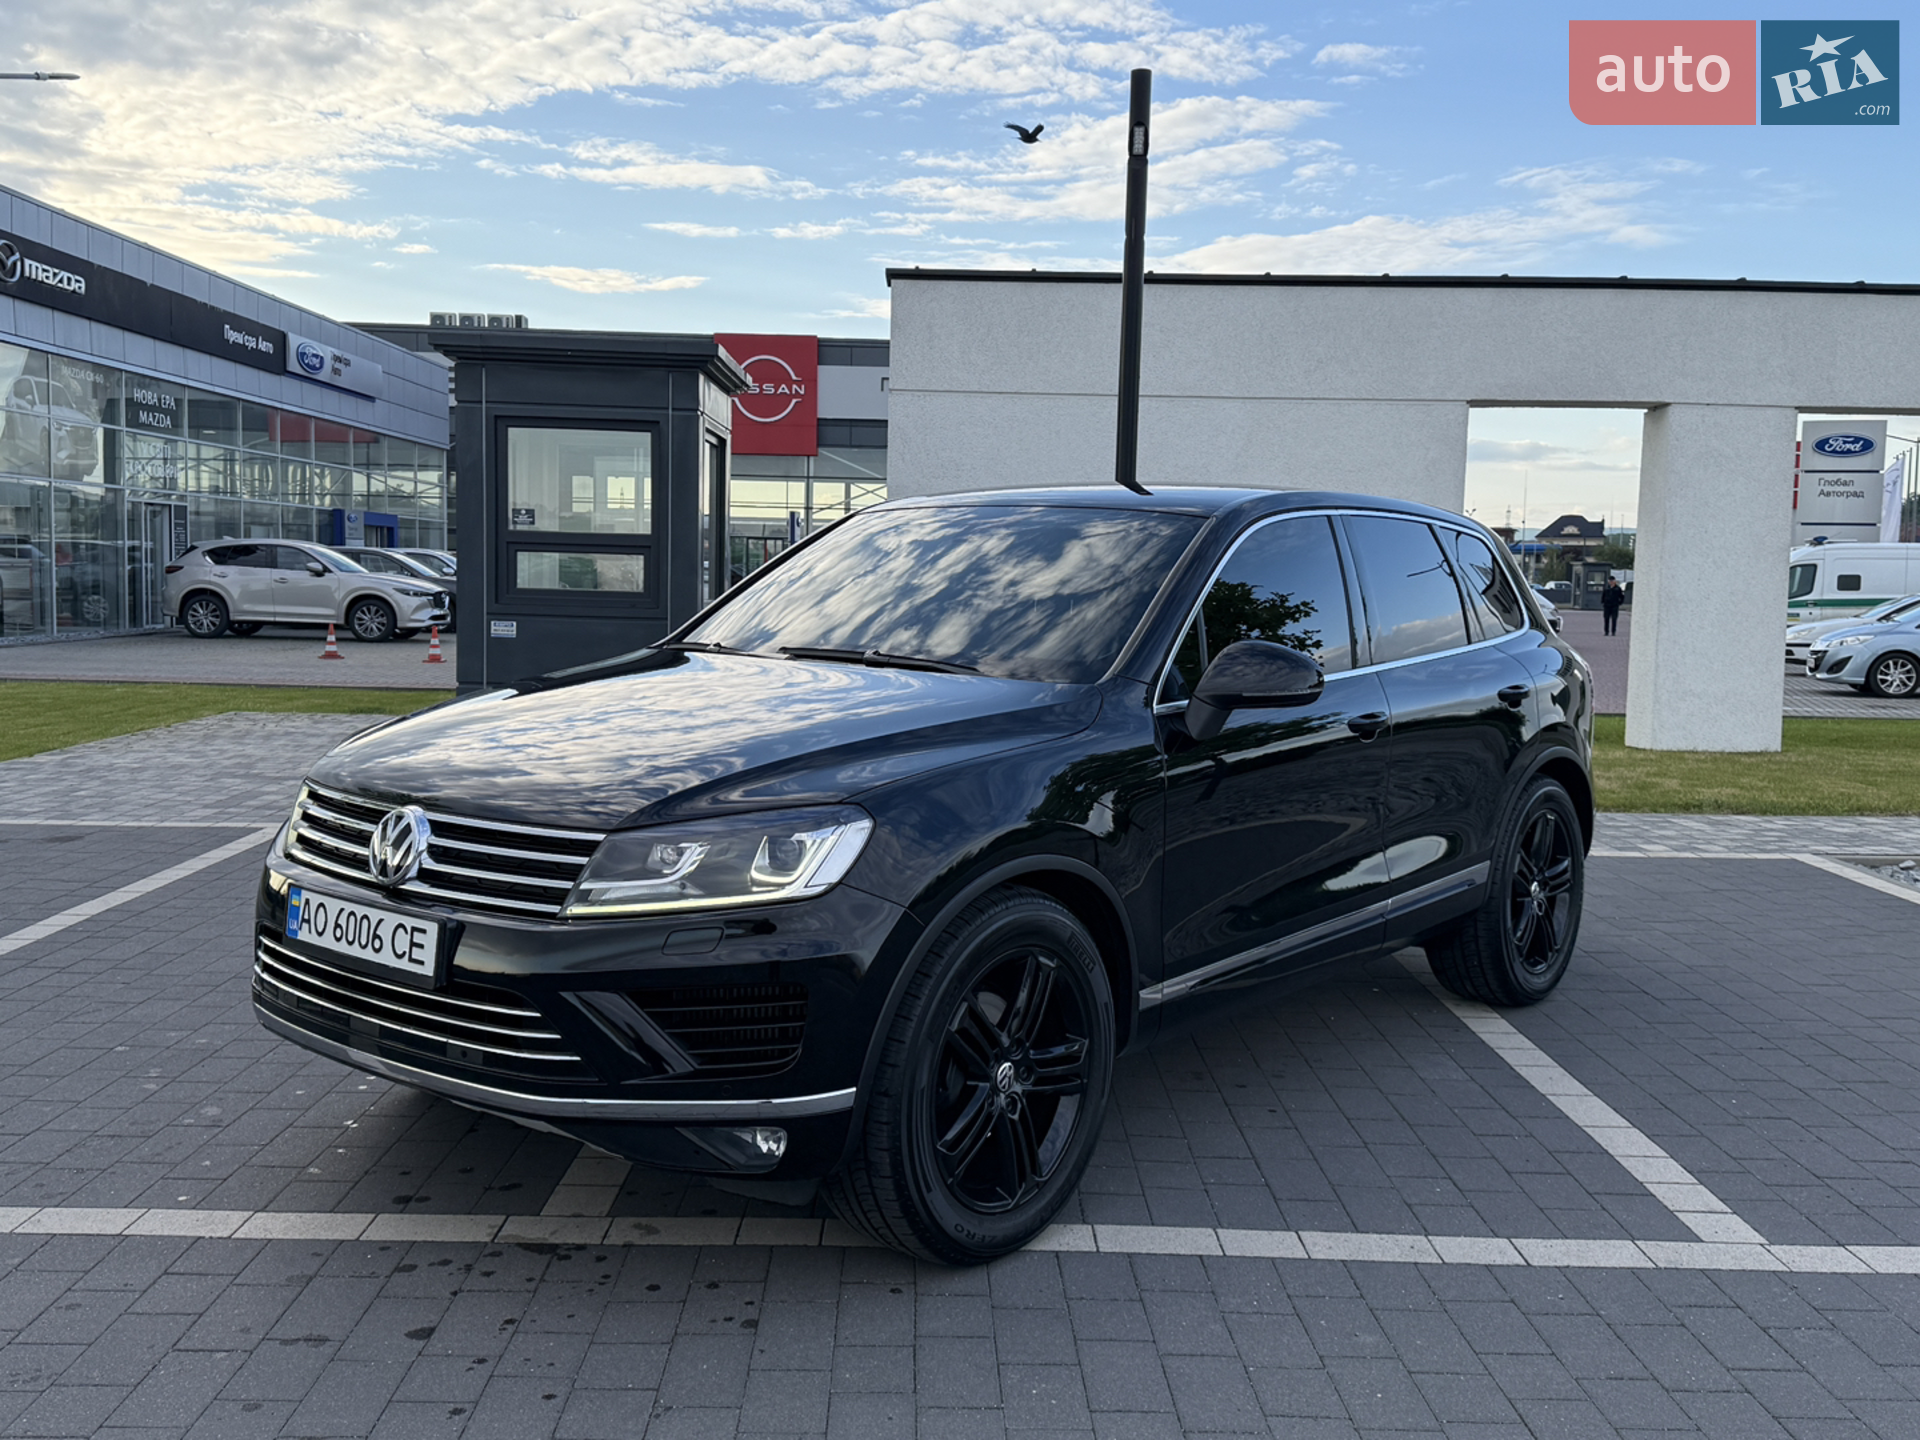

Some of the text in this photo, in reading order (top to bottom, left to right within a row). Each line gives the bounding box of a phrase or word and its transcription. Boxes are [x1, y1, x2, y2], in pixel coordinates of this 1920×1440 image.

[23, 257, 86, 295] mazda
[257, 335, 274, 354] Авто
[61, 365, 86, 380] MAZDA
[133, 387, 176, 411] НОВА ЕРА
[139, 410, 172, 429] MAZDA
[1825, 437, 1864, 452] Ford
[1818, 478, 1855, 487] Глобал
[1818, 489, 1865, 499] Автоград
[288, 918, 299, 931] UA
[298, 897, 428, 966] AO 6006 CE
[954, 1222, 998, 1244] ZERO
